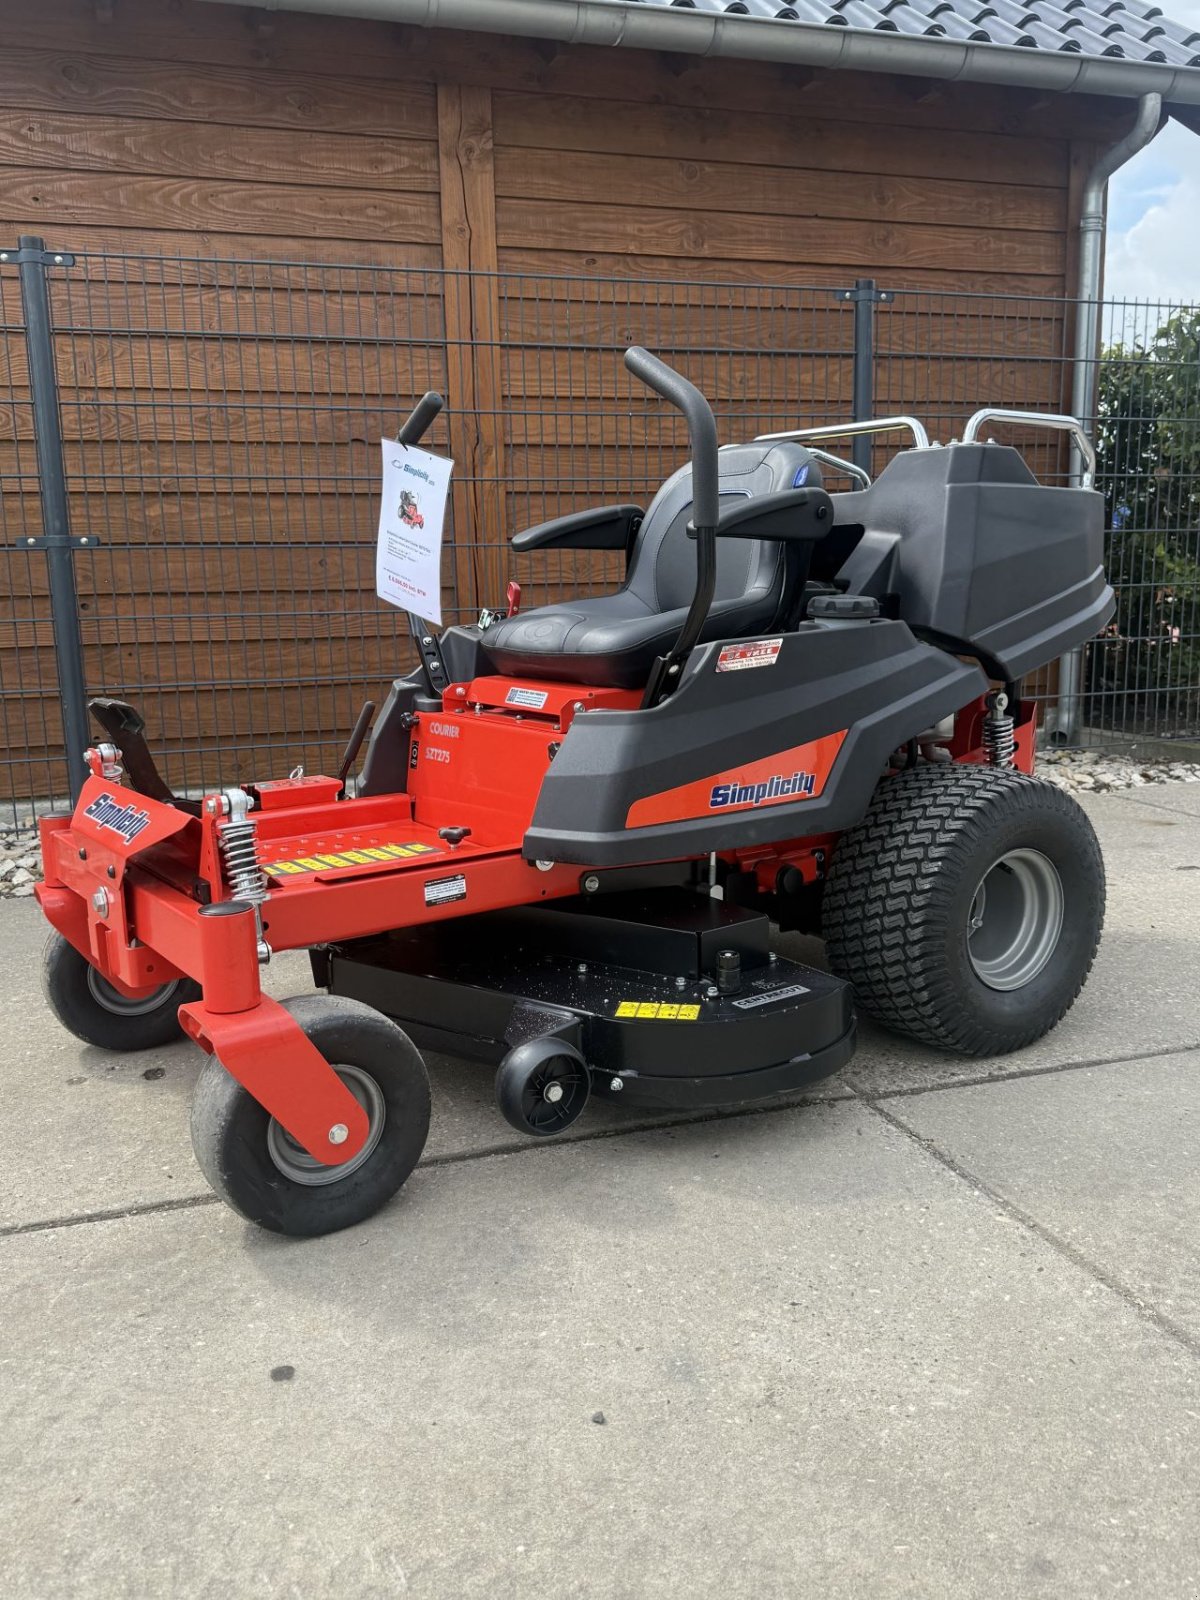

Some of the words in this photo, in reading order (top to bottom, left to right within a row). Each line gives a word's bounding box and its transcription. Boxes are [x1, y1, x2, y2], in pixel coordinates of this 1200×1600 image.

[403, 463, 430, 483] Simplicity
[430, 721, 460, 739] COURIER
[425, 747, 450, 764] SZT275
[709, 771, 816, 809] Simplicity
[83, 791, 152, 846] Simplicity
